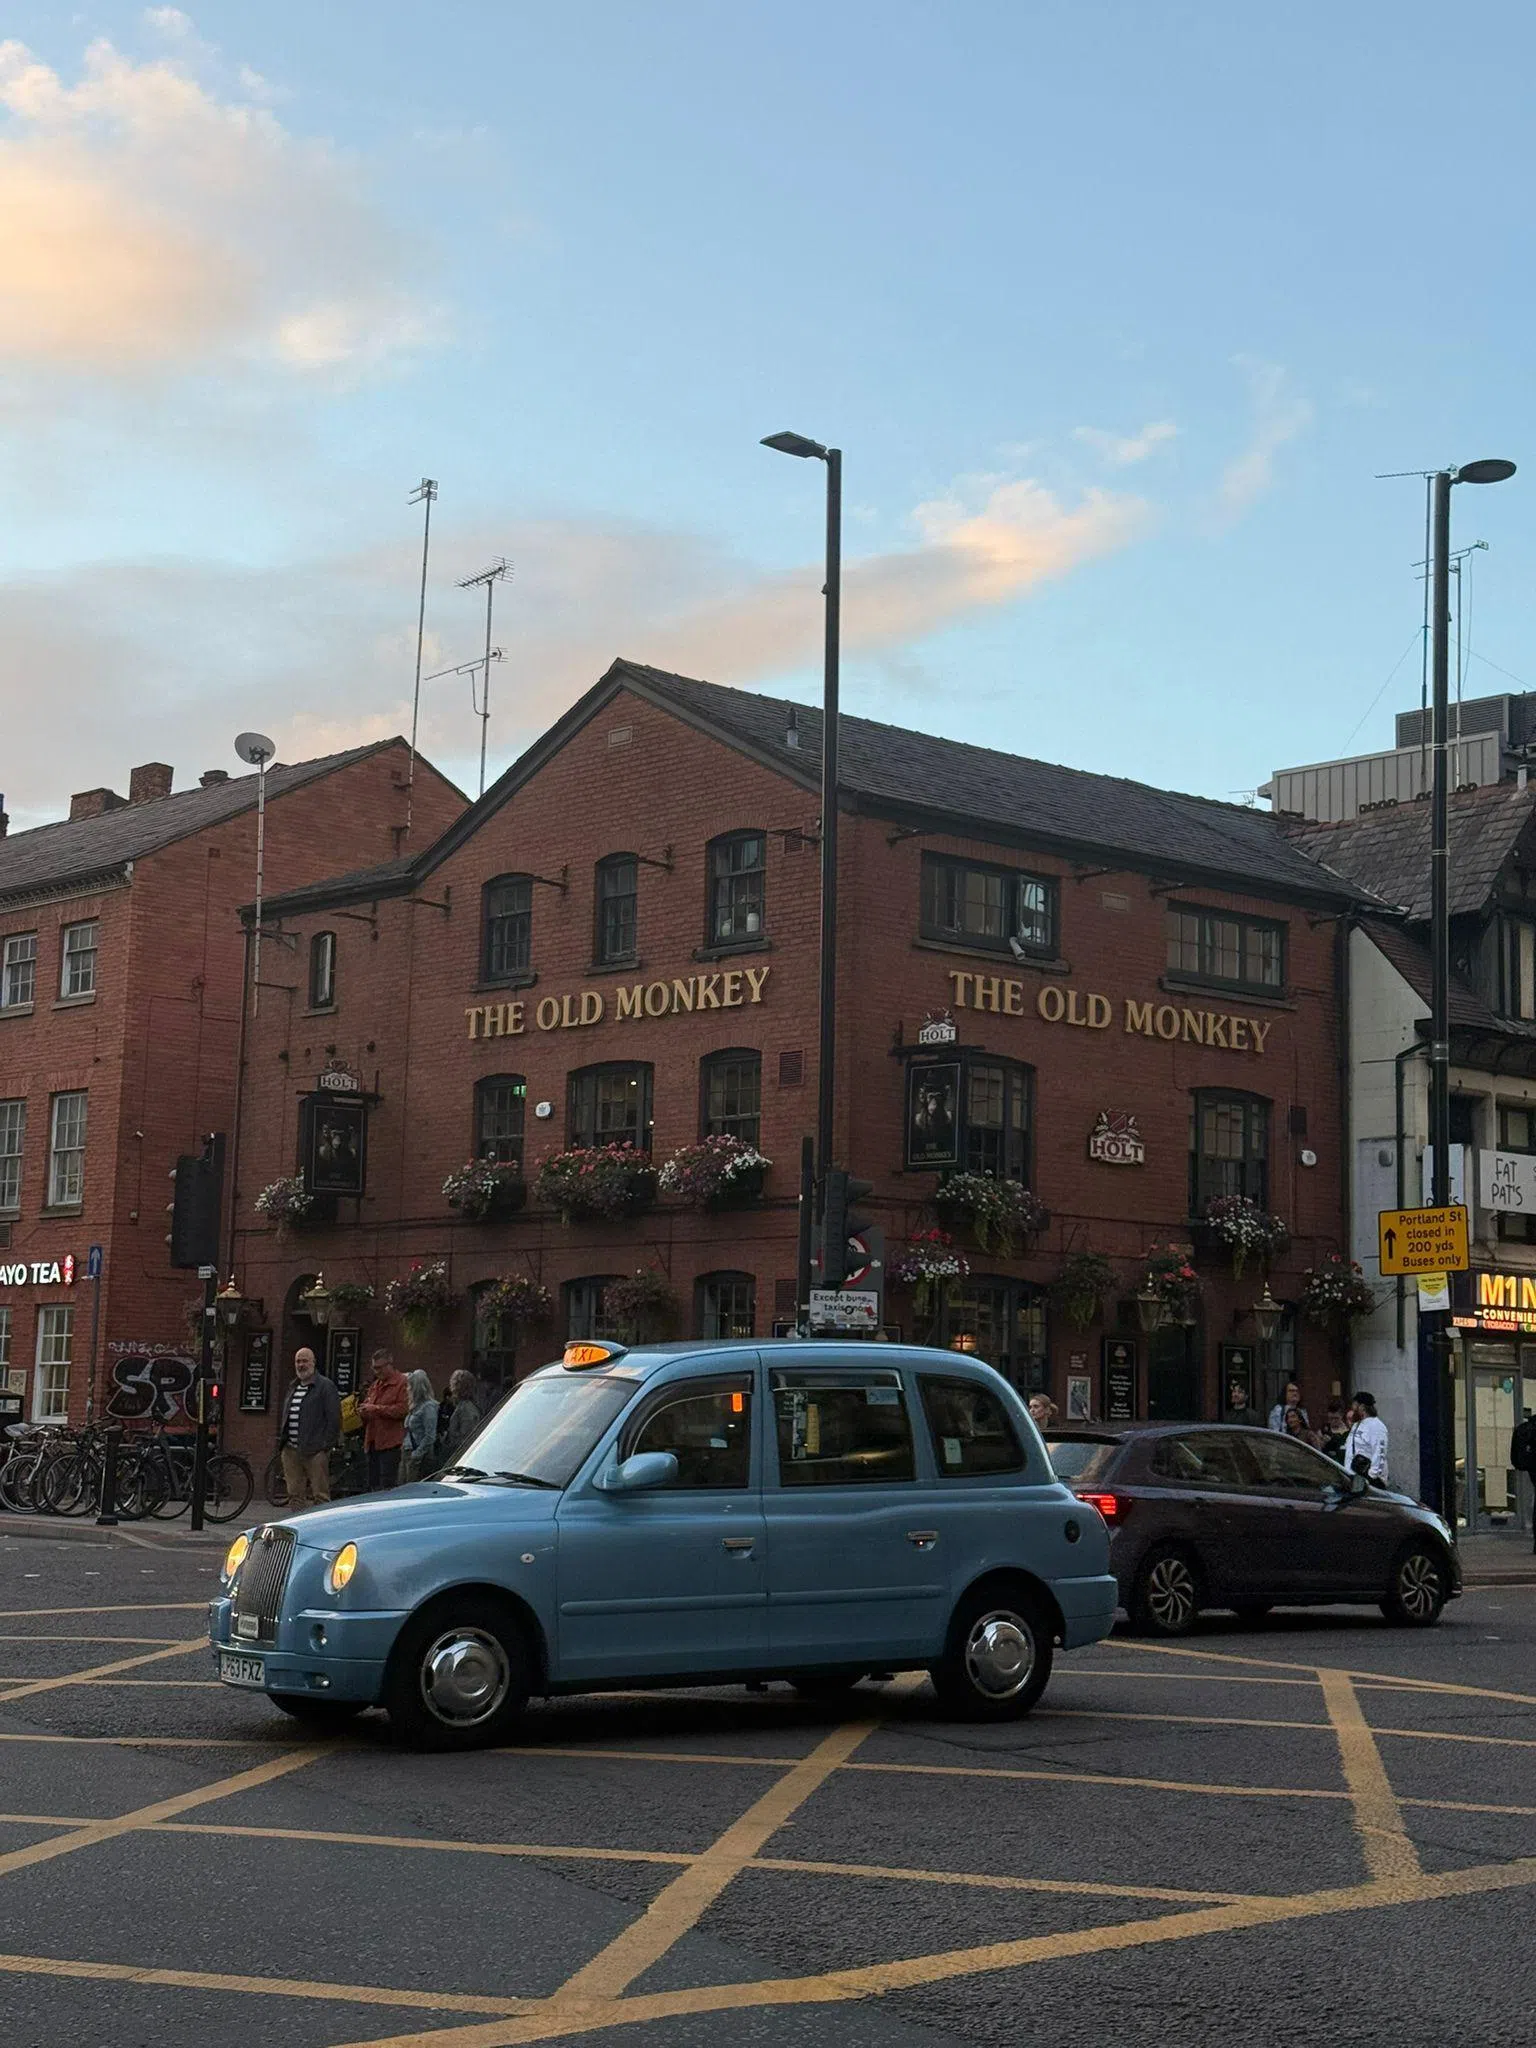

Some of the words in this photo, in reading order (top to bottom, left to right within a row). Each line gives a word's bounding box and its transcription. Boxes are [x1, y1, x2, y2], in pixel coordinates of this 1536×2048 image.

[464, 1001, 525, 1039] THE
[536, 991, 603, 1031] OLD
[614, 967, 770, 1021] MONKEY
[949, 970, 1024, 1016] THE
[1037, 986, 1112, 1029] OLD
[1124, 999, 1271, 1053] MONKEY
[921, 1029, 954, 1041] HOLT
[323, 1078, 357, 1089] HOLT
[1092, 1139, 1142, 1158] HOLT
[1495, 1158, 1517, 1183] FAT
[1492, 1183, 1523, 1206] PAT'S
[1399, 1213, 1445, 1225] Portland
[1449, 1211, 1461, 1222] St
[1406, 1227, 1441, 1239] closed
[1445, 1226, 1454, 1237] in
[1408, 1241, 1432, 1253] 200
[1435, 1240, 1454, 1253] yds
[1402, 1256, 1435, 1267] Buses
[1438, 1254, 1461, 1266] only
[30, 1261, 61, 1284] TEA
[813, 1294, 844, 1304] Except
[242, 1660, 262, 1681] FXZ
